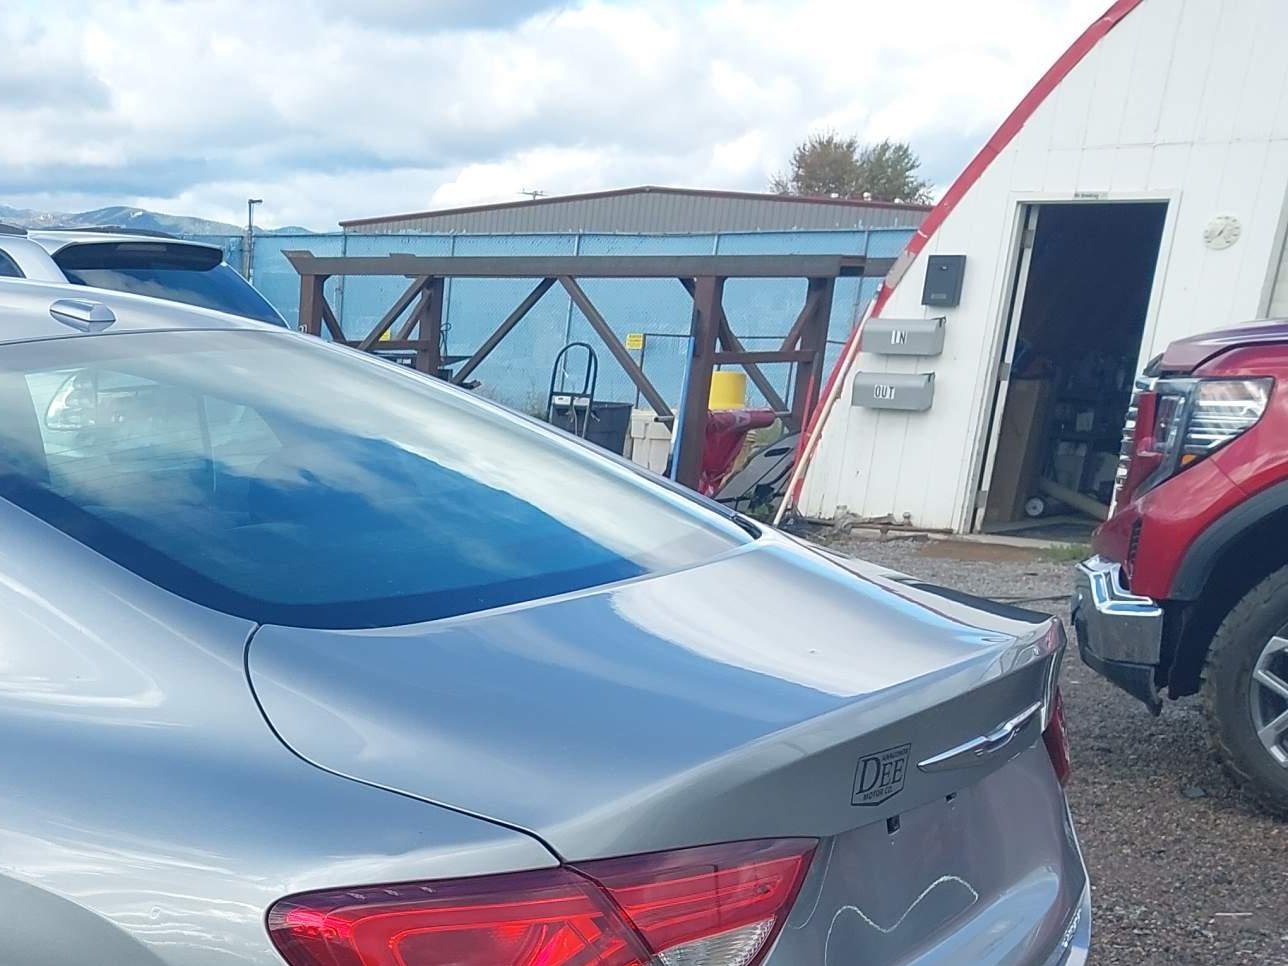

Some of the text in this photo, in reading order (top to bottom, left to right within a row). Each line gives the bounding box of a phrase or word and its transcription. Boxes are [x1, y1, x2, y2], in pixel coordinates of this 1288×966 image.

[892, 330, 907, 344] IN
[875, 385, 894, 399] OUT
[856, 757, 905, 795] DEE
